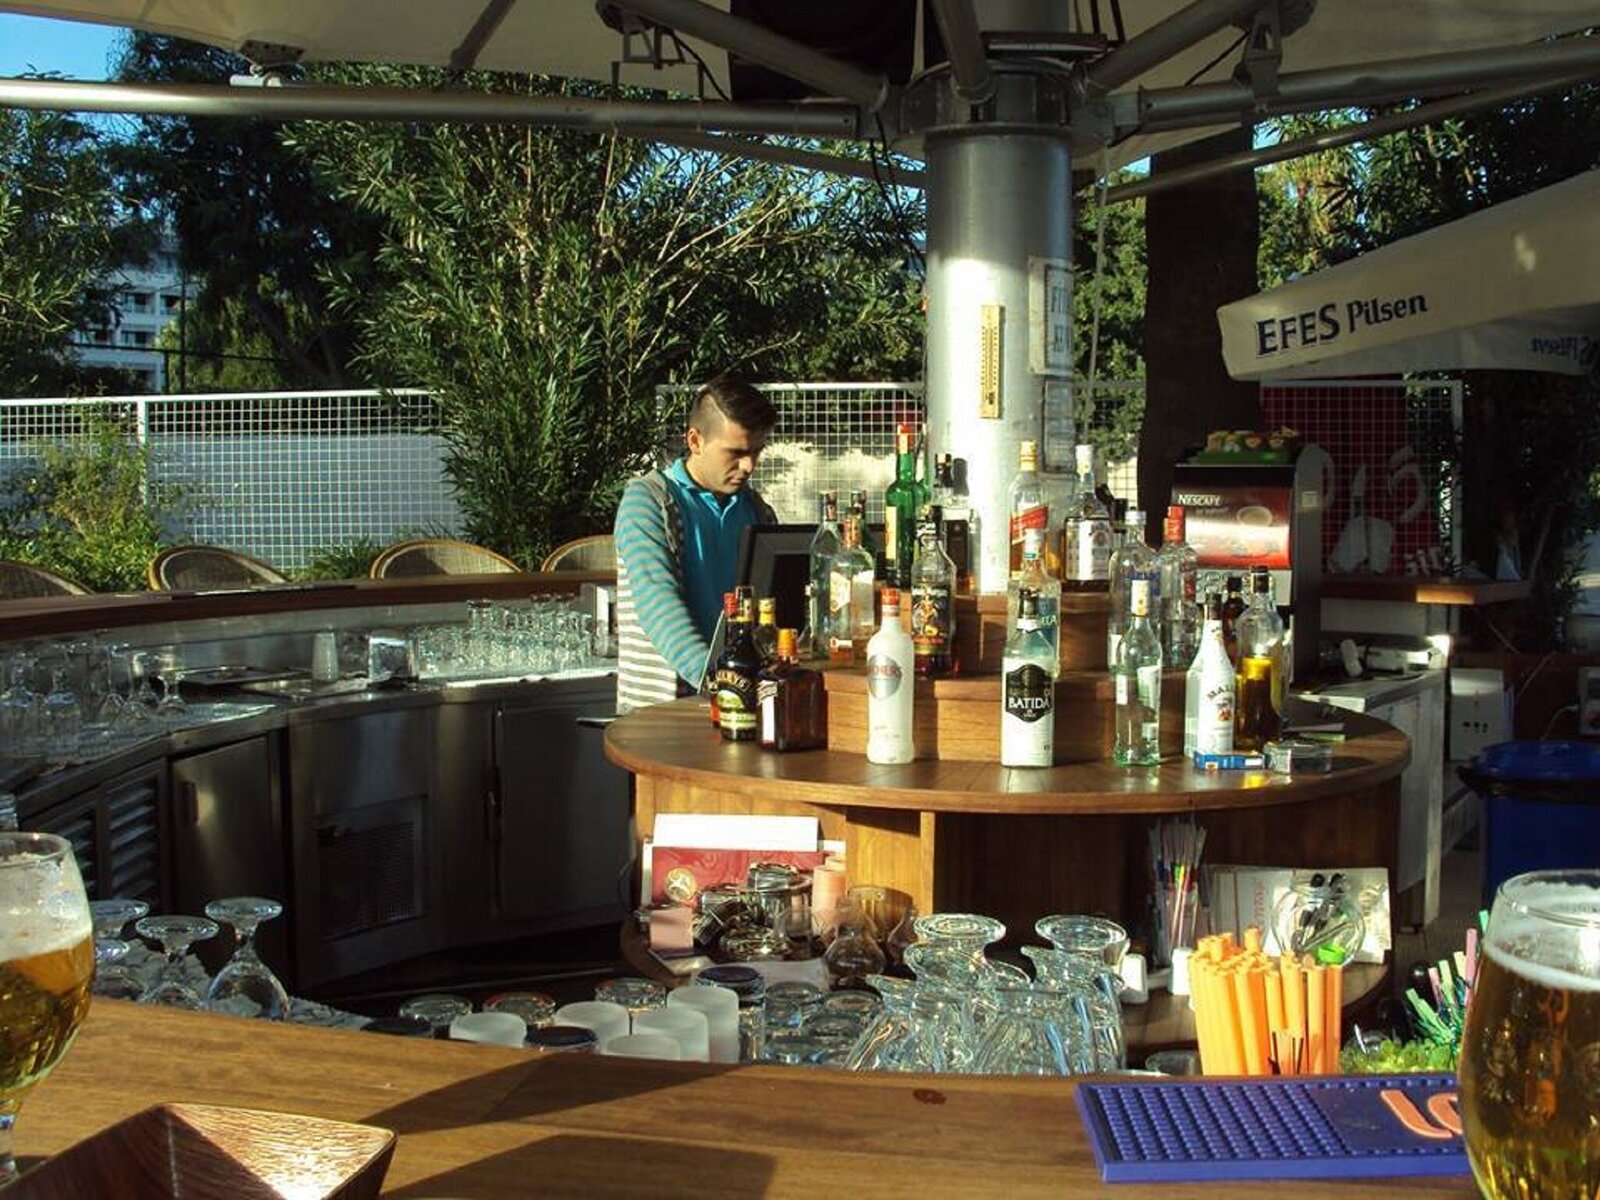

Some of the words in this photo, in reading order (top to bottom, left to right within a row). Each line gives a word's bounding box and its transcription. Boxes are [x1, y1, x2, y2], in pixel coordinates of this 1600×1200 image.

[1256, 303, 1340, 356] EFES
[1347, 294, 1428, 333] Pilsen
[1008, 696, 1051, 709] BATIDA
